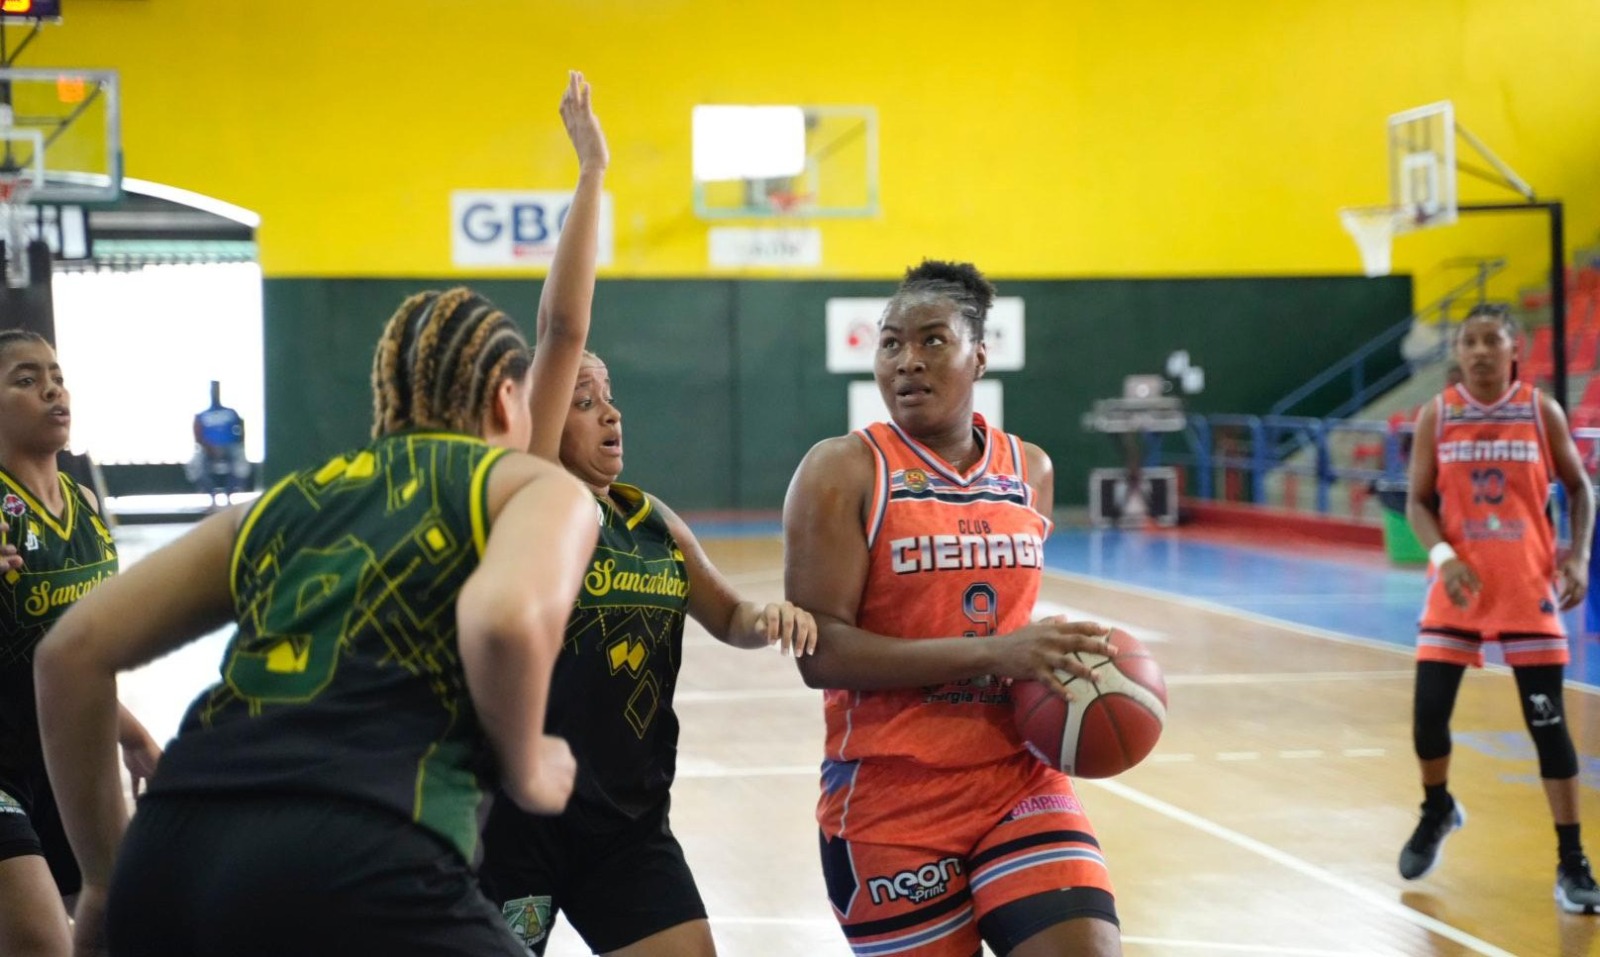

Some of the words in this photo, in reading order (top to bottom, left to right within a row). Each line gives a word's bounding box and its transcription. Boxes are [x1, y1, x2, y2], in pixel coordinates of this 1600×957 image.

[462, 203, 571, 244] GB
[1471, 468, 1504, 505] 10
[958, 519, 991, 534] CLUB
[962, 582, 997, 638] 9
[868, 858, 961, 904] neon
